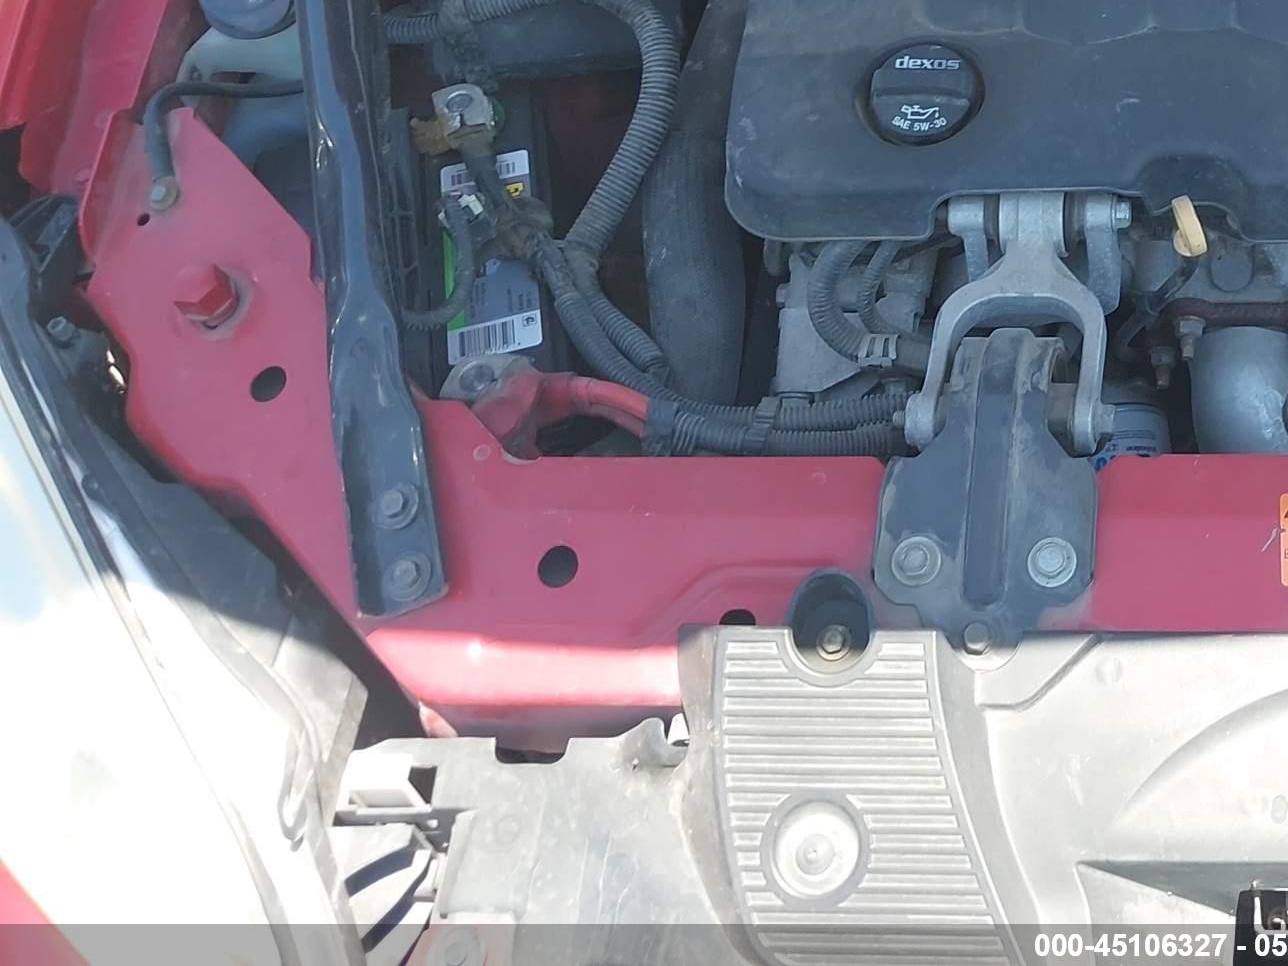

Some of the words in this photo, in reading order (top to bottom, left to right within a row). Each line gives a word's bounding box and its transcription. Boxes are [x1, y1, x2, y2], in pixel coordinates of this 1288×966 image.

[895, 55, 961, 70] dexos
[891, 115, 911, 130] SAE
[913, 117, 947, 131] 5W-30
